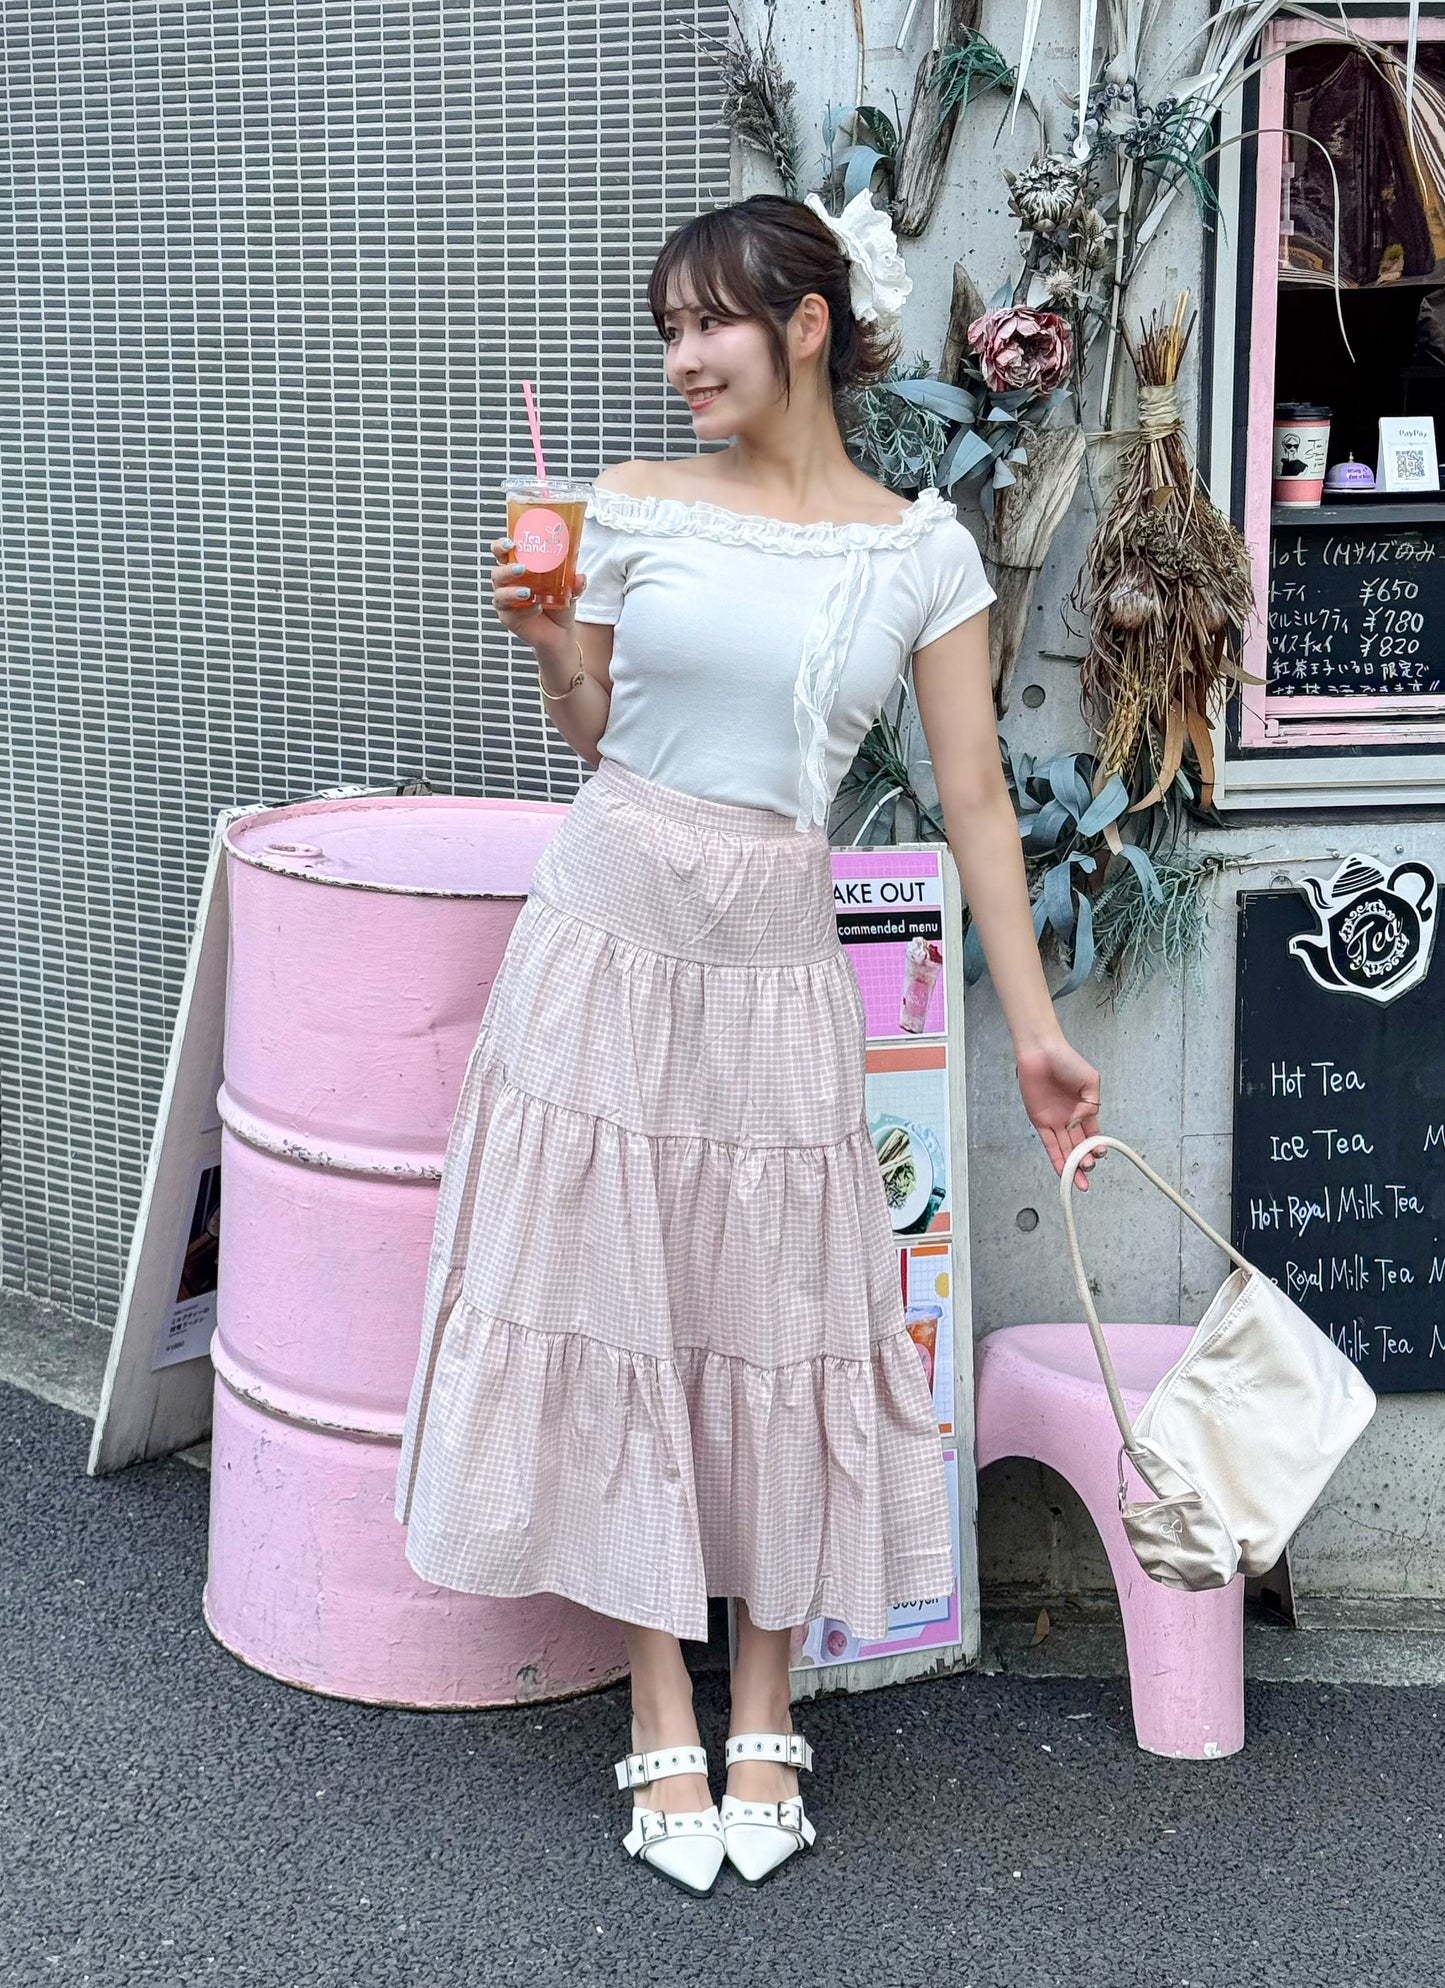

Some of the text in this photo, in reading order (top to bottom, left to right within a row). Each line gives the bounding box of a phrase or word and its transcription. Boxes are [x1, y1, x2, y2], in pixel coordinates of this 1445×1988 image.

[523, 531, 541, 544] Tea
[1359, 577, 1419, 607] ¥650
[1363, 606, 1424, 634] ¥780
[1360, 633, 1420, 658] ¥820
[834, 882, 926, 904] AKE OUT
[838, 919, 938, 936] commended menu
[1347, 917, 1403, 971] Tea
[1271, 1060, 1366, 1099] Hot Tea
[1270, 1135, 1309, 1161] Ice
[1312, 1128, 1374, 1160] Tea
[1250, 1184, 1424, 1238] Hot Royal Milk Tea
[1286, 1257, 1323, 1303] Royal
[1330, 1253, 1369, 1292] Milk
[1374, 1258, 1414, 1292] Tea
[1330, 1319, 1370, 1363] Milk
[1374, 1325, 1414, 1363] Tea
